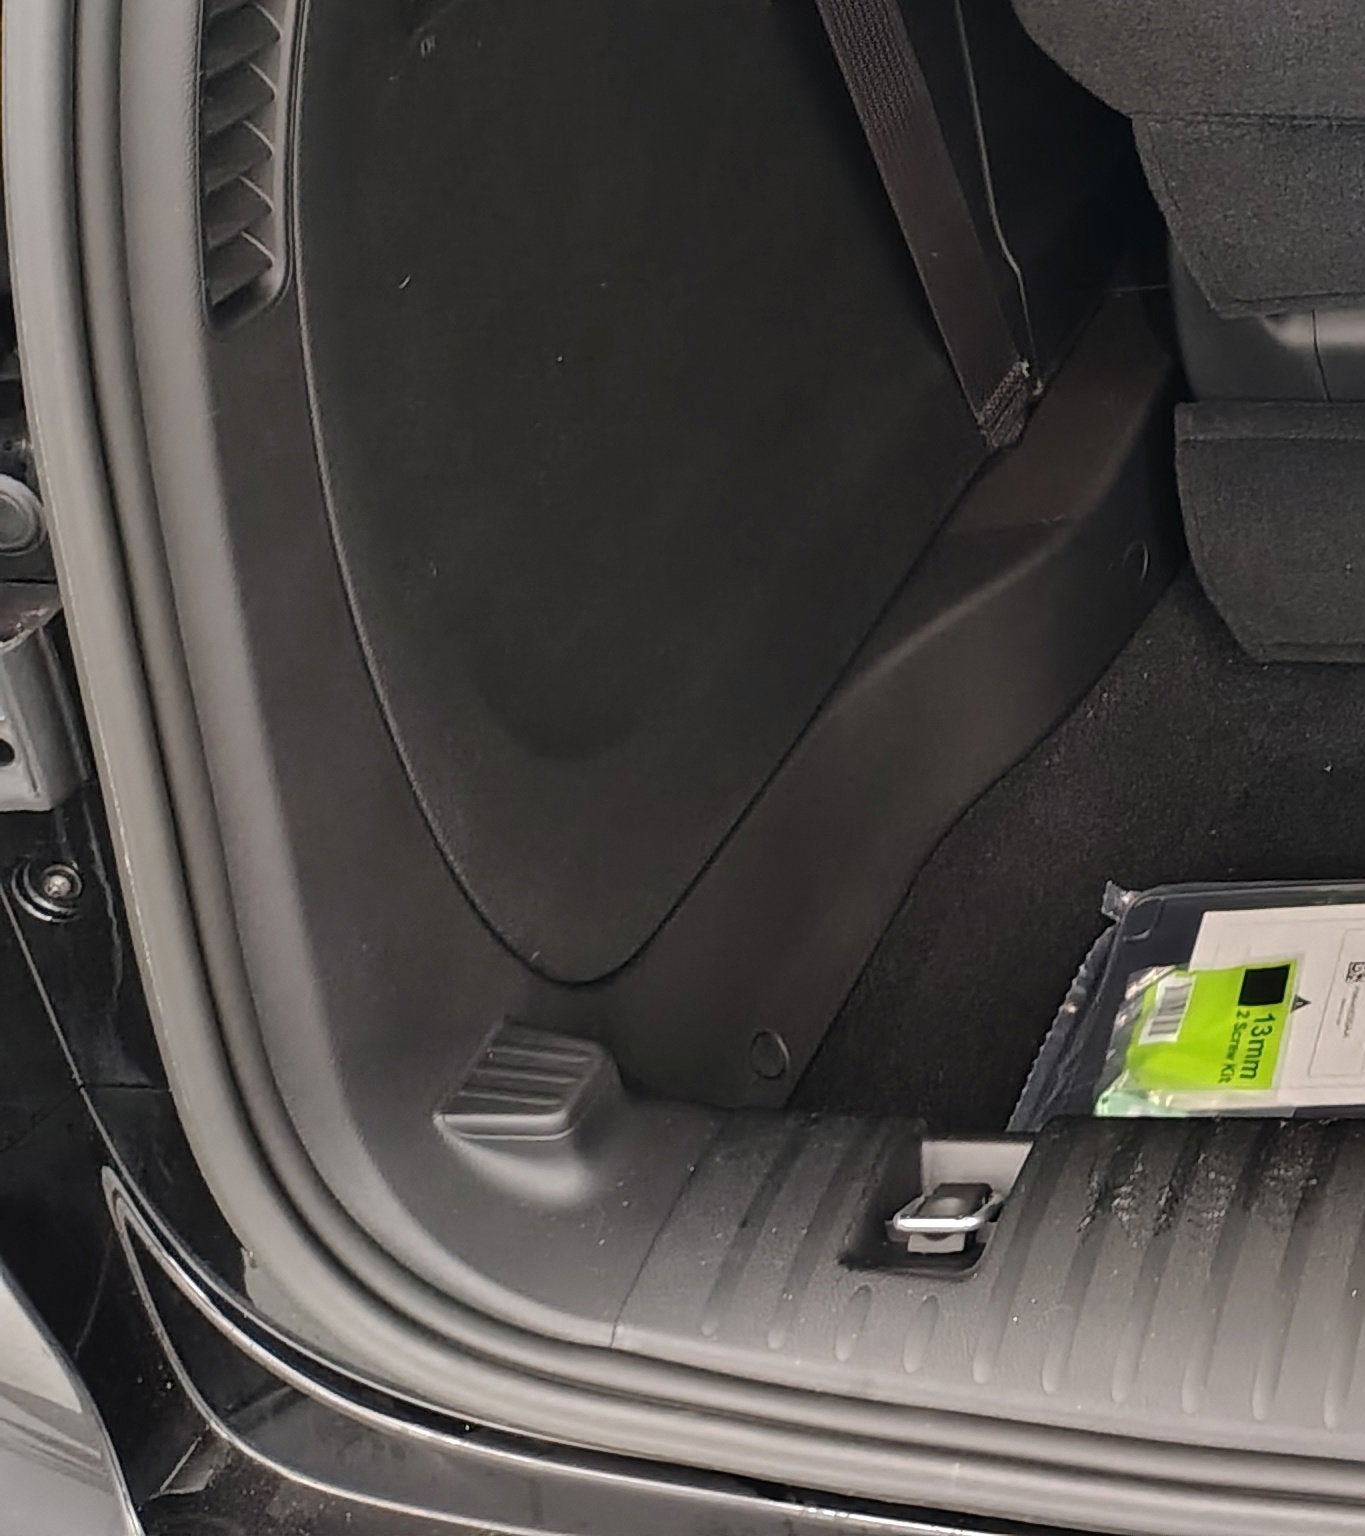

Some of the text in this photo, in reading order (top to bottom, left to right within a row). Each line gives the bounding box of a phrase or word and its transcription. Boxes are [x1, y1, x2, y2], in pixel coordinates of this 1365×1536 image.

[1218, 1010, 1250, 1083] 2 Screw Kit
[1239, 1013, 1276, 1079] 13mm
